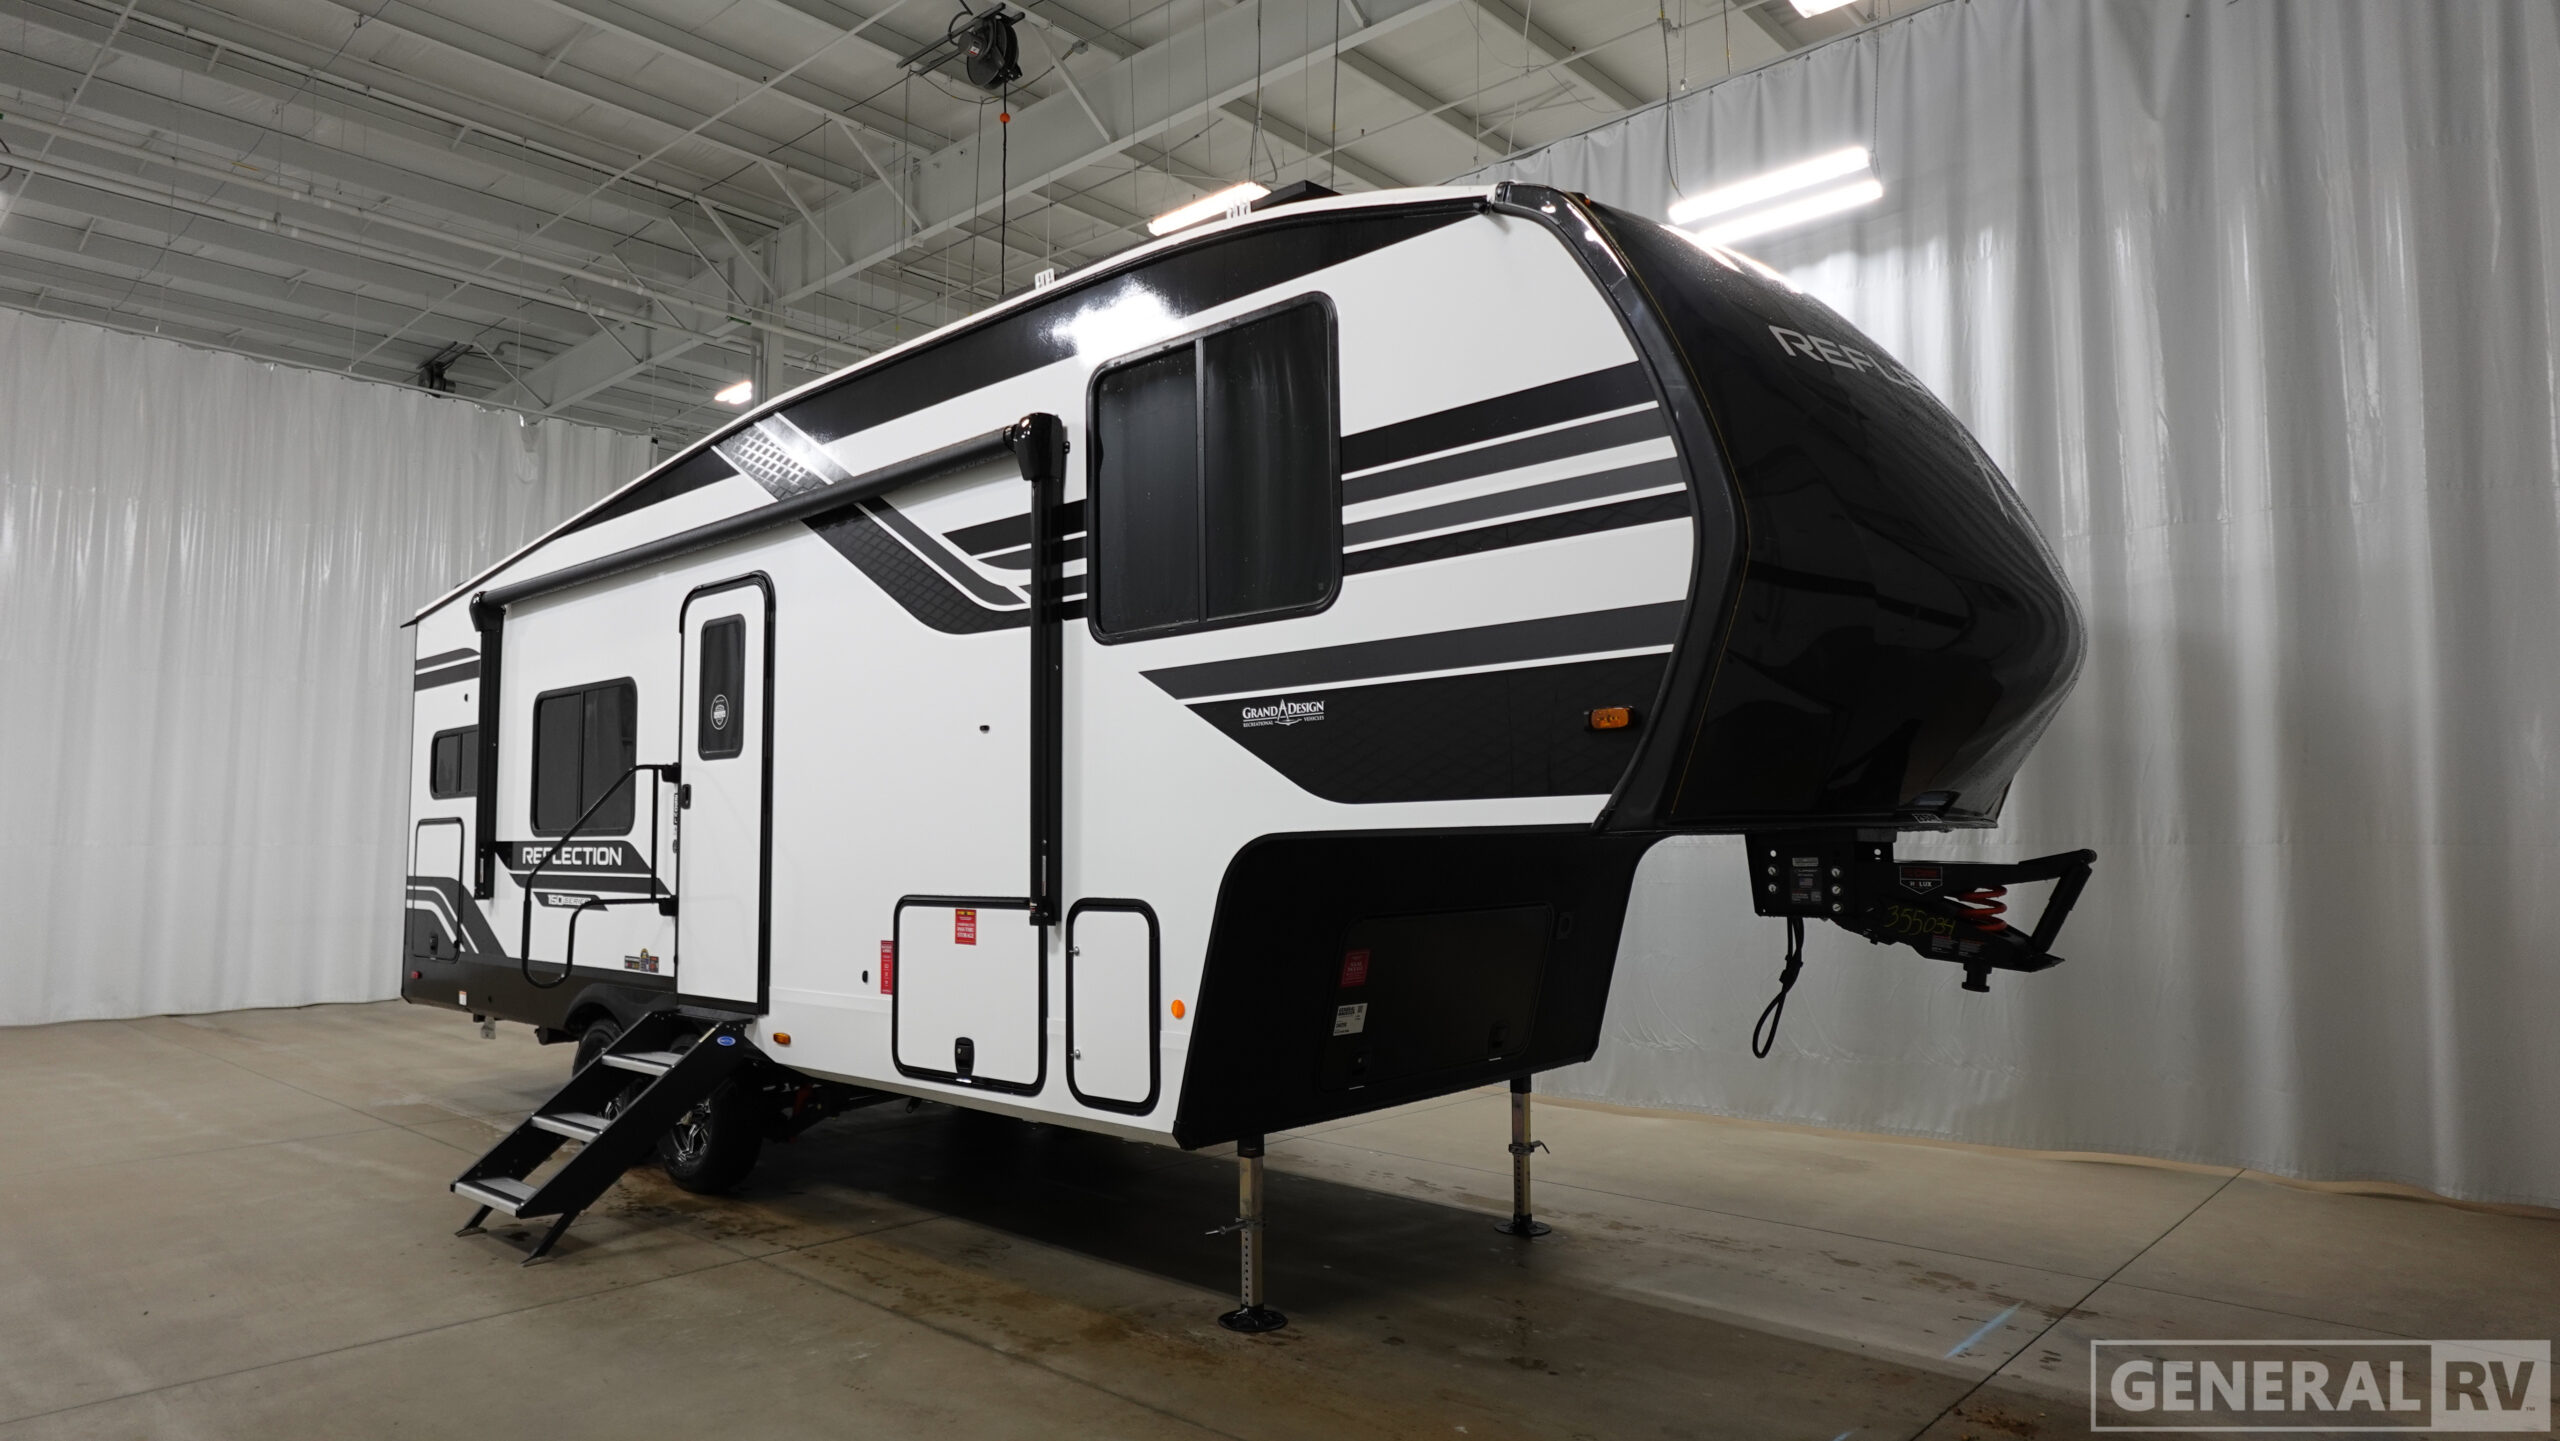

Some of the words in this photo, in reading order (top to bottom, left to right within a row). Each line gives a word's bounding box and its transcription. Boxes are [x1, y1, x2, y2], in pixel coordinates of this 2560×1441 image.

[1242, 706, 1278, 719] GRAND
[1287, 700, 1325, 715] DESIGN
[1883, 904, 1956, 936] 355034
